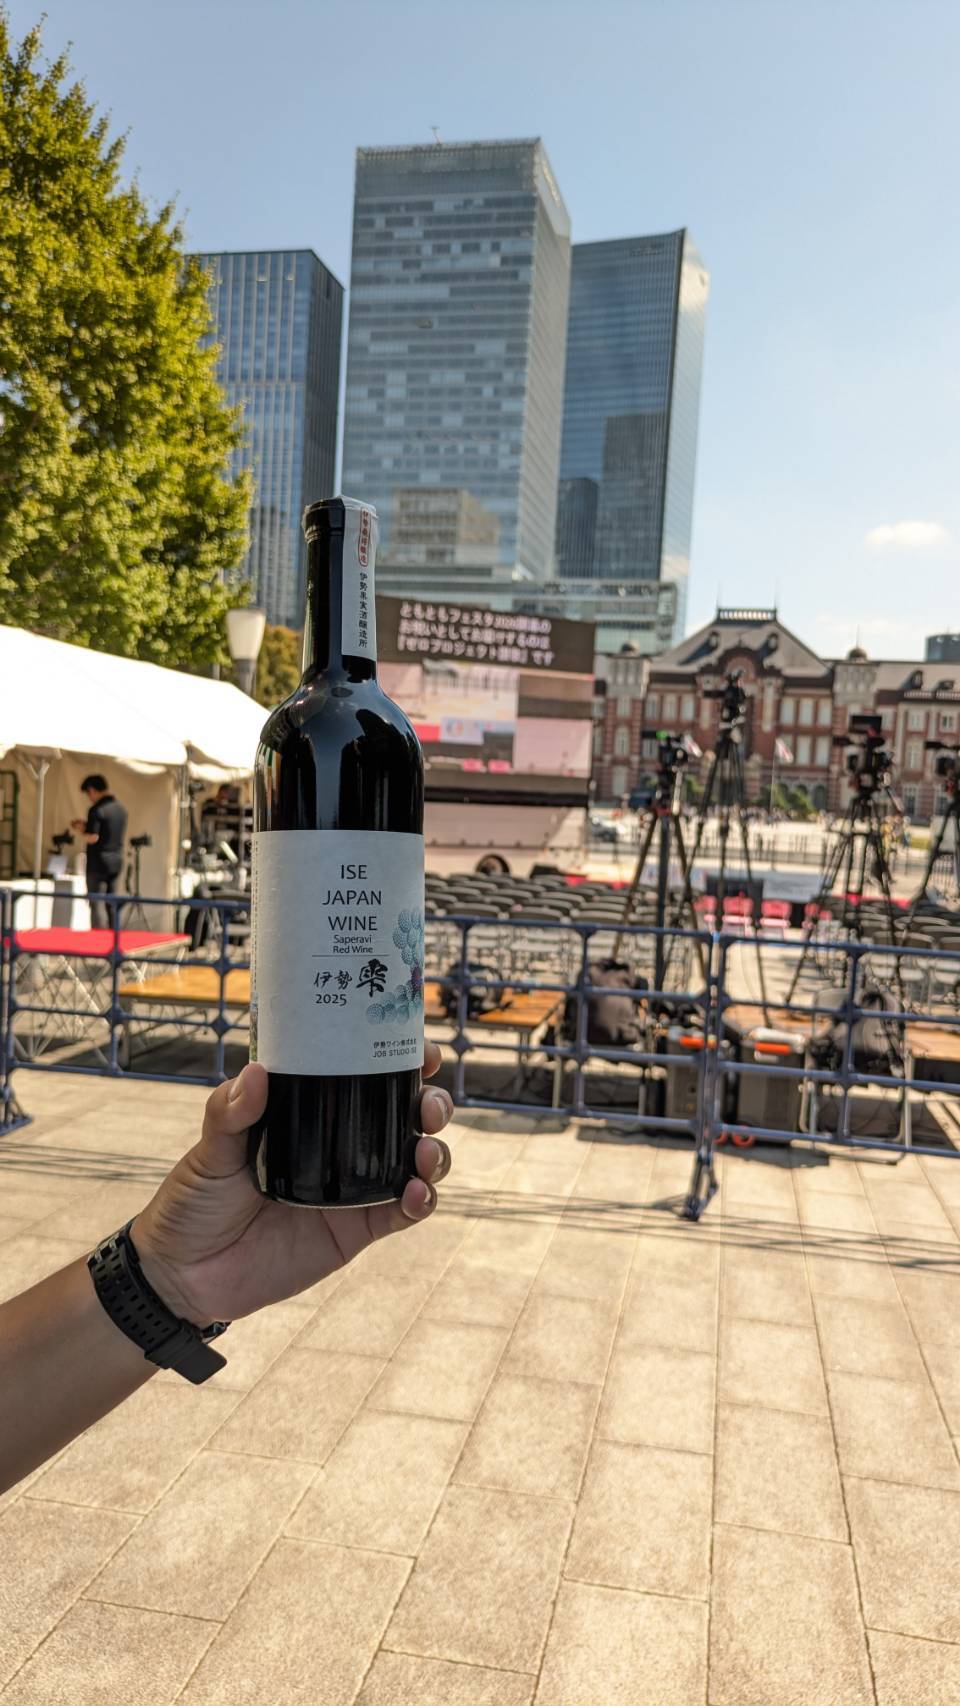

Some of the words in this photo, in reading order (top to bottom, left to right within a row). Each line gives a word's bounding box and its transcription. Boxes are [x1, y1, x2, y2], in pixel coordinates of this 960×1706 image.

[358, 572, 368, 648] 伊勢果実酒醸造所
[340, 864, 368, 880] ISE
[322, 890, 382, 906] JAPAN
[328, 916, 378, 931] WINE
[333, 934, 372, 945] Saperavi
[333, 945, 350, 954] Red
[351, 945, 374, 954] Wine
[315, 993, 347, 1007] 2025
[372, 1049, 387, 1058] JOB
